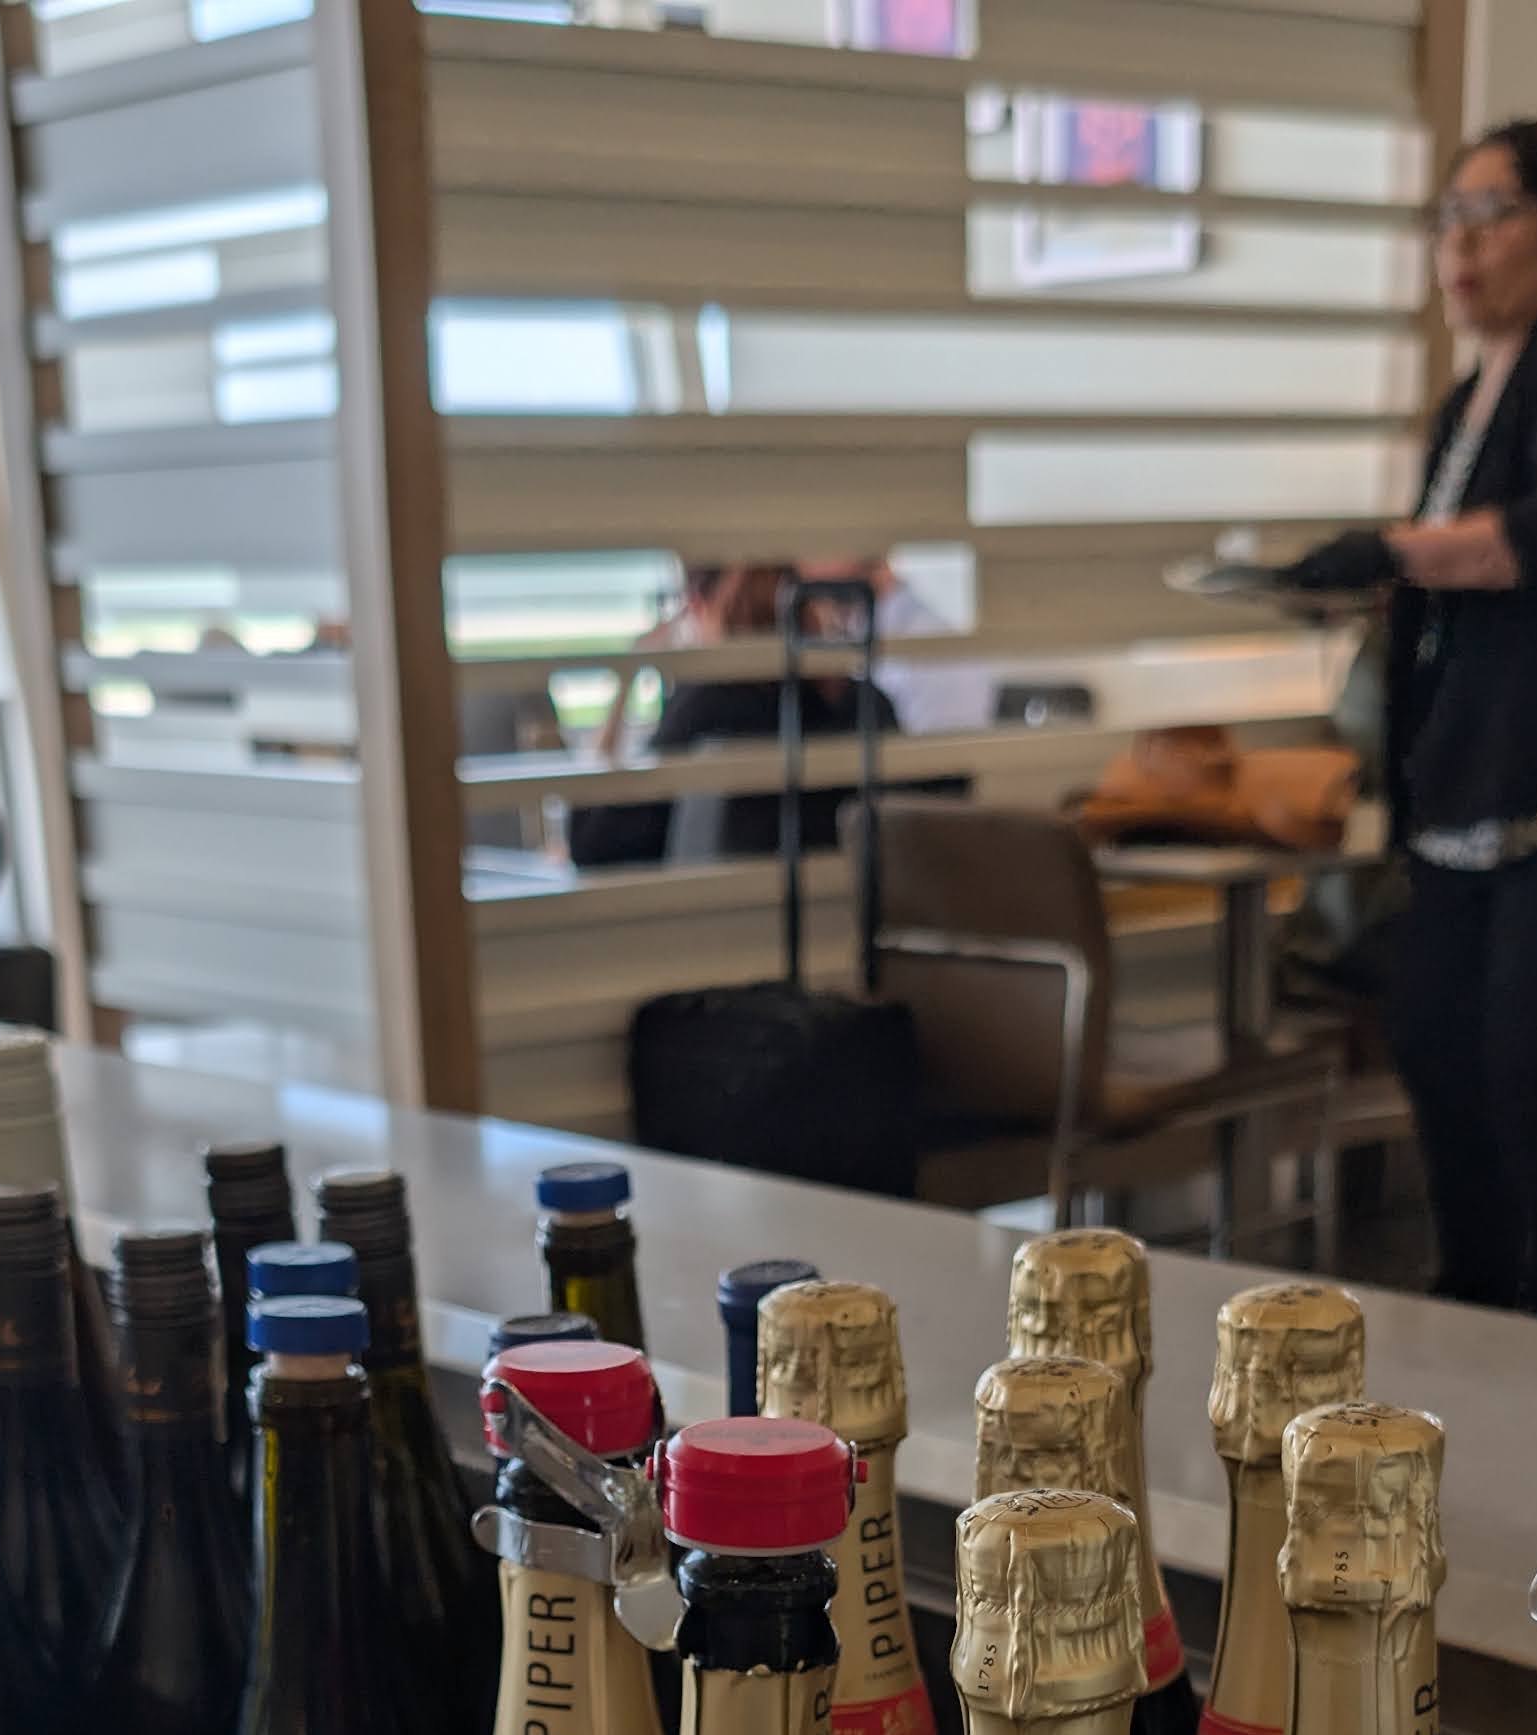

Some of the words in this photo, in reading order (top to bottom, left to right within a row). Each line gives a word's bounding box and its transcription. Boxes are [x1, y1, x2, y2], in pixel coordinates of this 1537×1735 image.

[860, 1511, 904, 1660] PIPER
[1334, 1551, 1350, 1595] 1785
[977, 1643, 997, 1692] 1785
